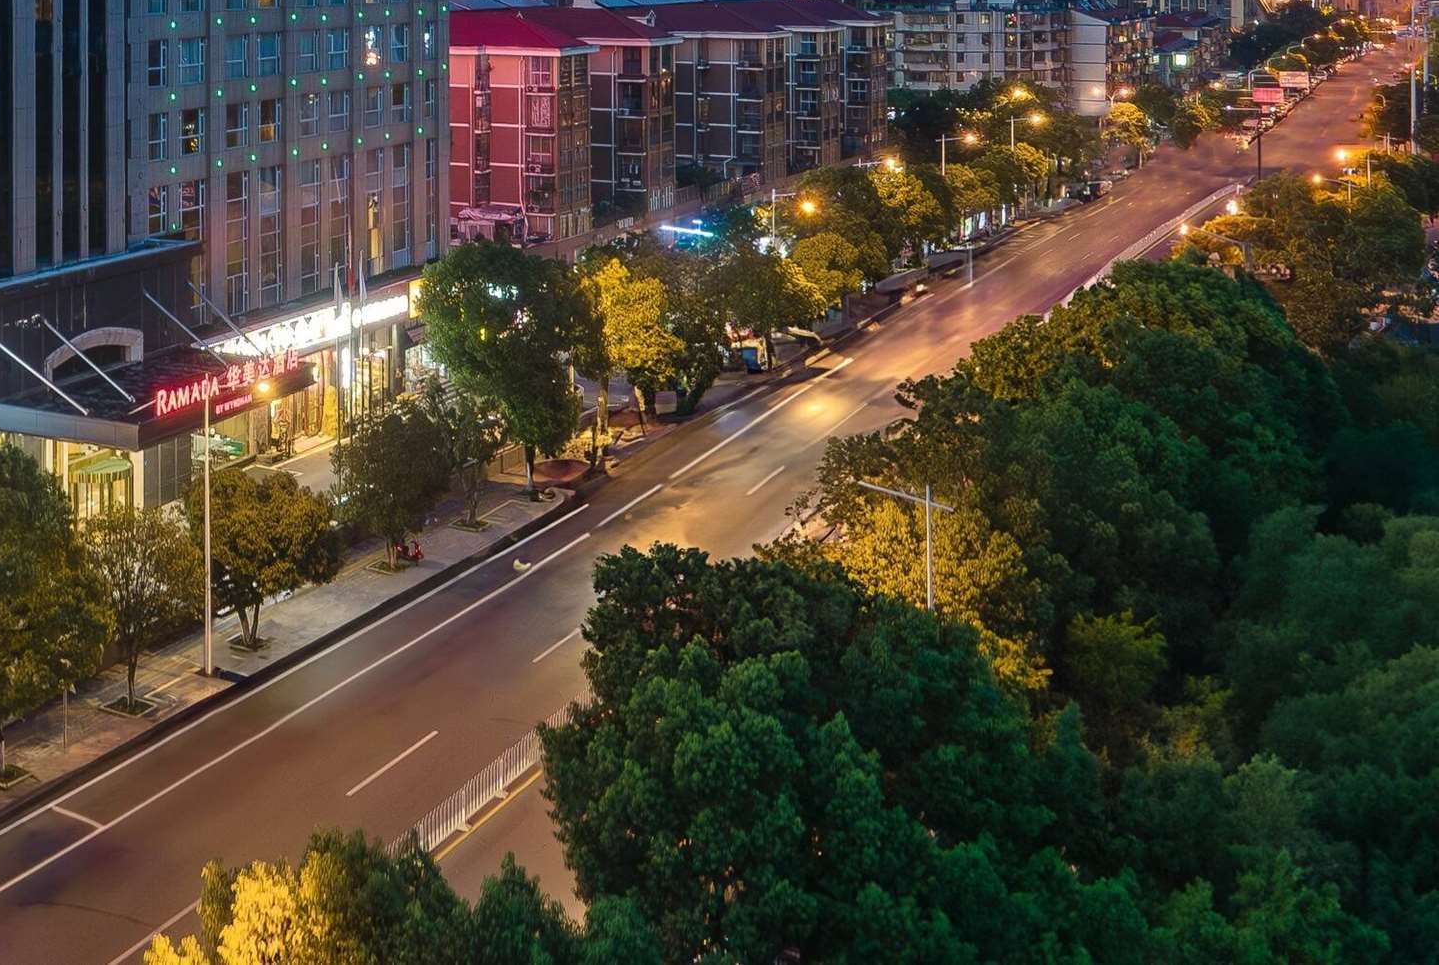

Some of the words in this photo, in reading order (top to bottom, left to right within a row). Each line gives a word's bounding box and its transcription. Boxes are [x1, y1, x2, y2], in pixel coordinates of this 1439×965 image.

[225, 347, 300, 391] 华美达酒店
[156, 376, 221, 417] RAMADA
